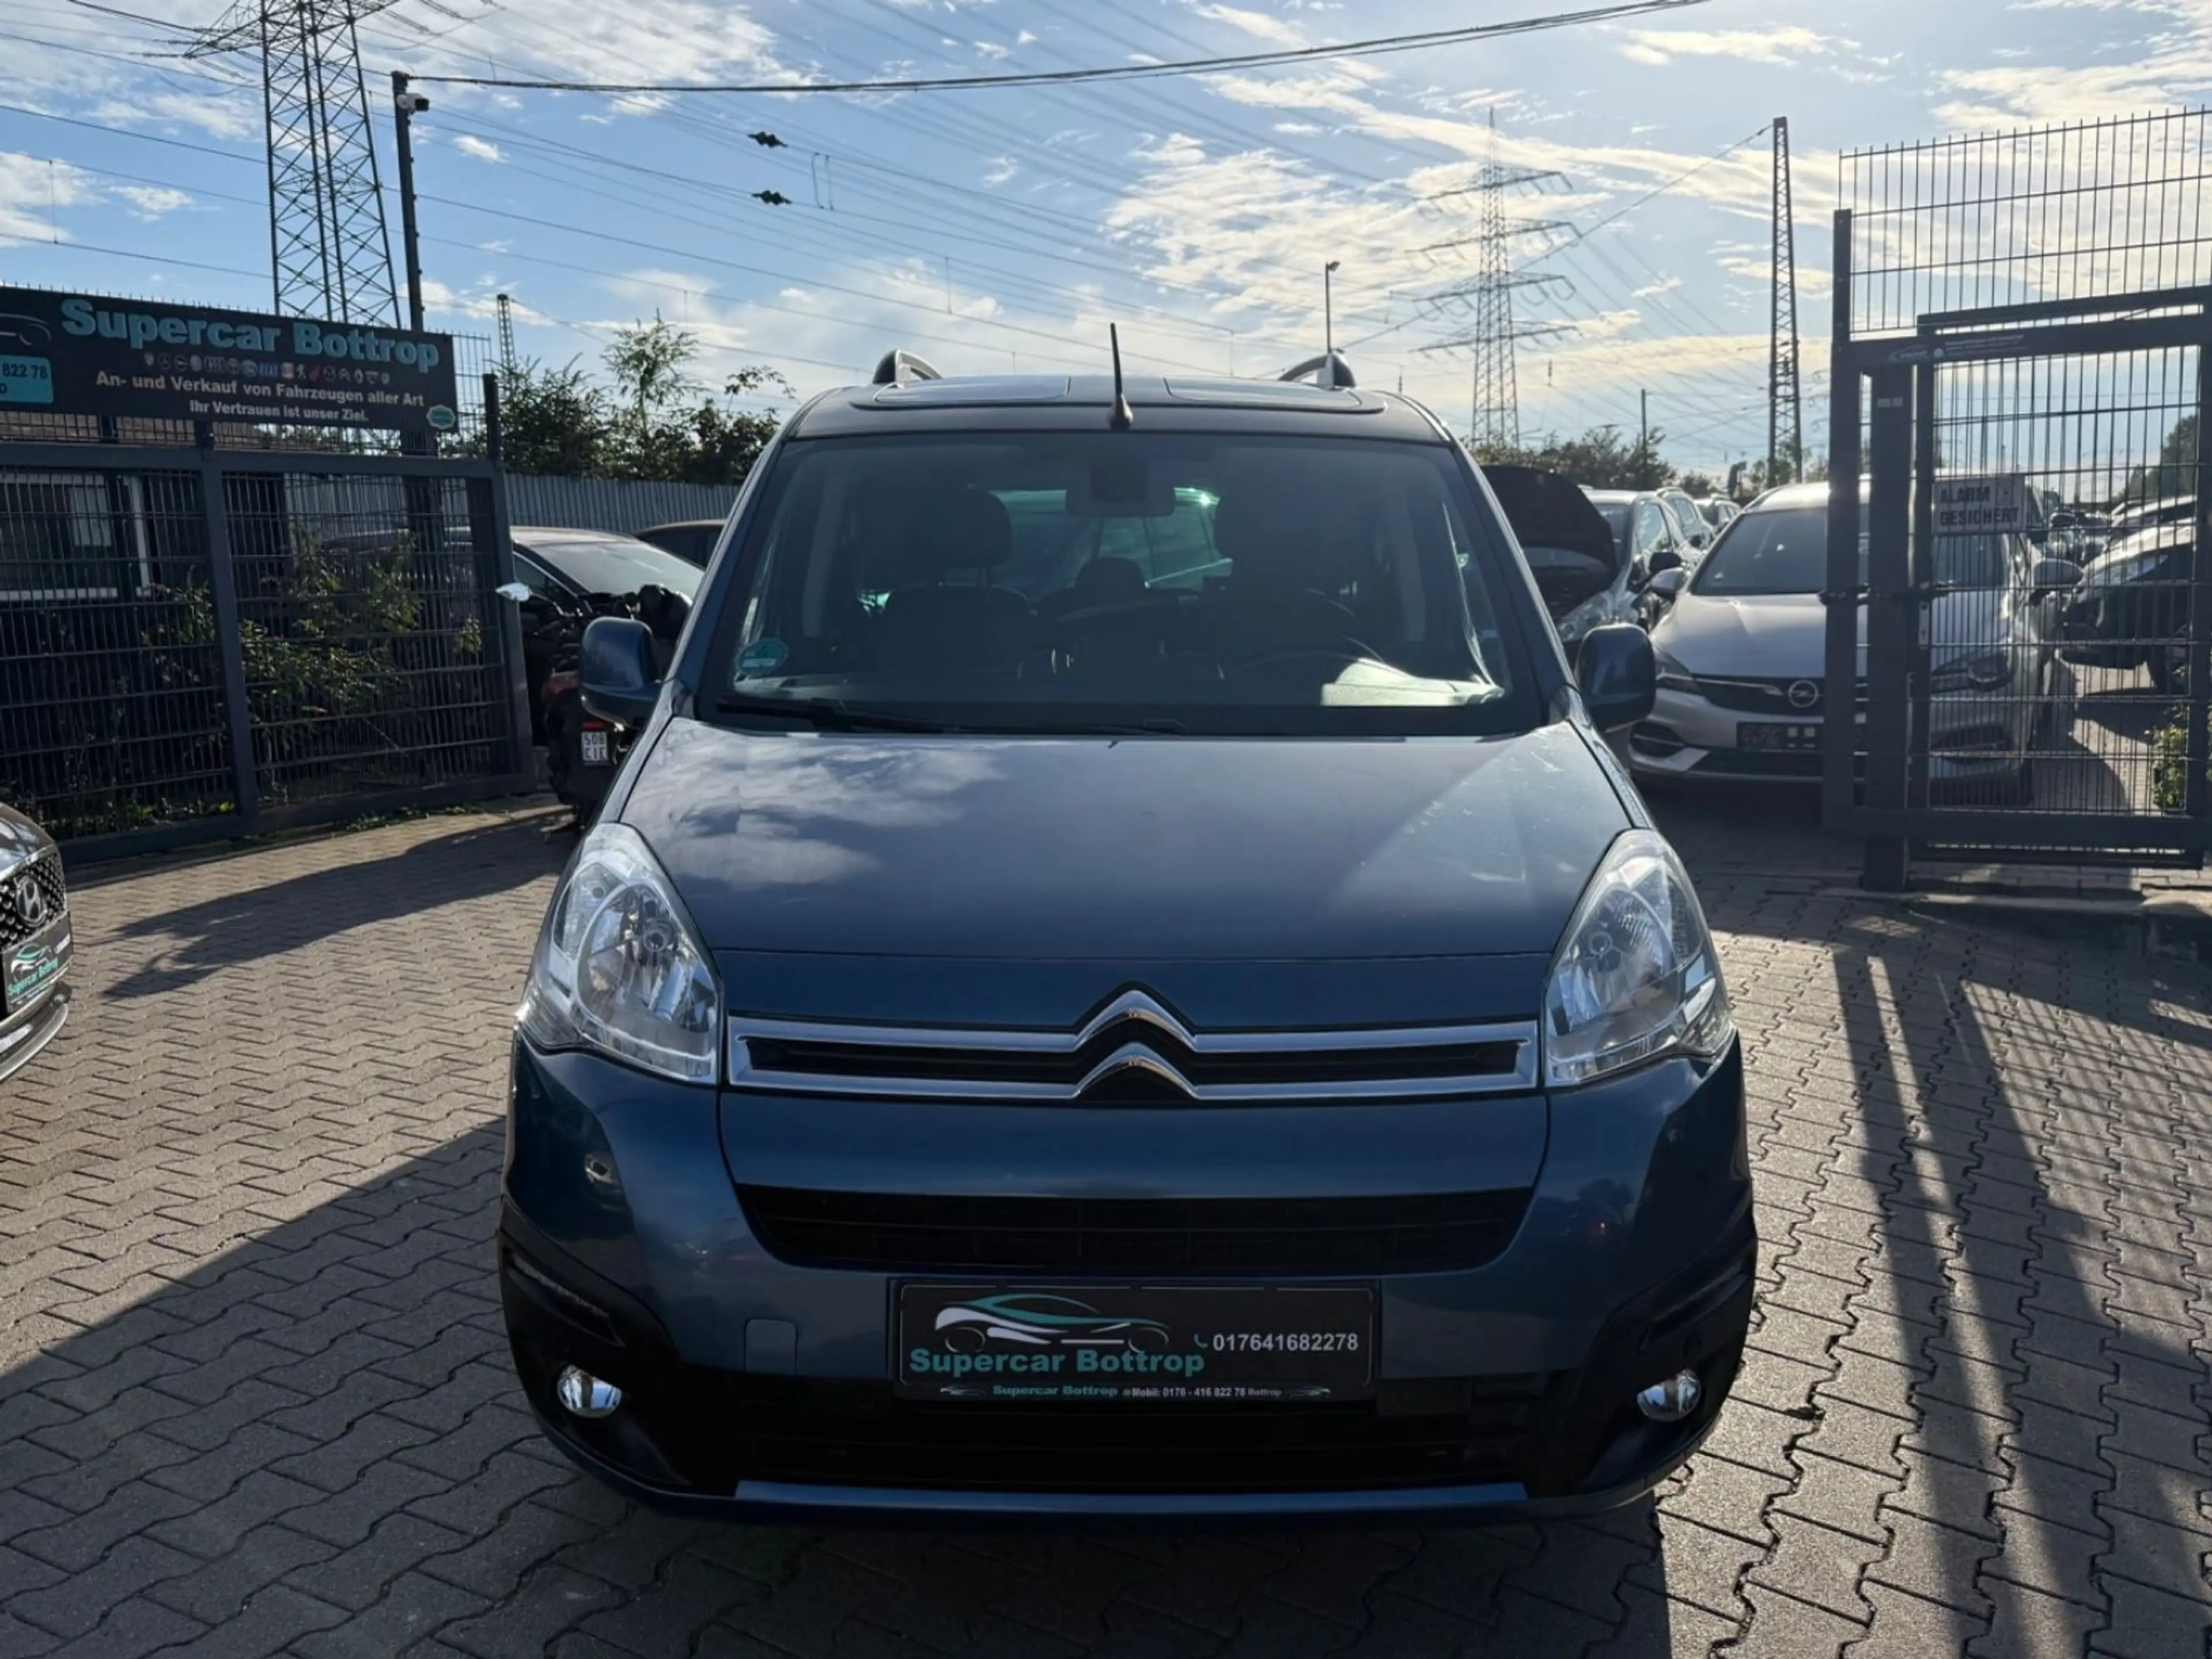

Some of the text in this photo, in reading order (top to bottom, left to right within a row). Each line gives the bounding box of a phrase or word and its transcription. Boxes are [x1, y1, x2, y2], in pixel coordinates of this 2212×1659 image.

[61, 298, 440, 373] Supercar Bottrop
[2, 362, 47, 379] 822 78
[96, 370, 425, 406] An- und Verkauf von Fahrzeugen aller Art
[190, 399, 210, 412] Ihr
[211, 401, 281, 416] Vertrauen
[302, 408, 340, 421] unser
[342, 408, 369, 422] Ziel.
[1940, 486, 1991, 503] ALARM
[1940, 507, 2018, 525] GESICHERT
[1213, 1332, 1359, 1351] 017641682278
[910, 1348, 1205, 1377] Supercar Bottrop
[993, 1385, 1059, 1397] Supercar
[1062, 1385, 1118, 1397] Bottrop
